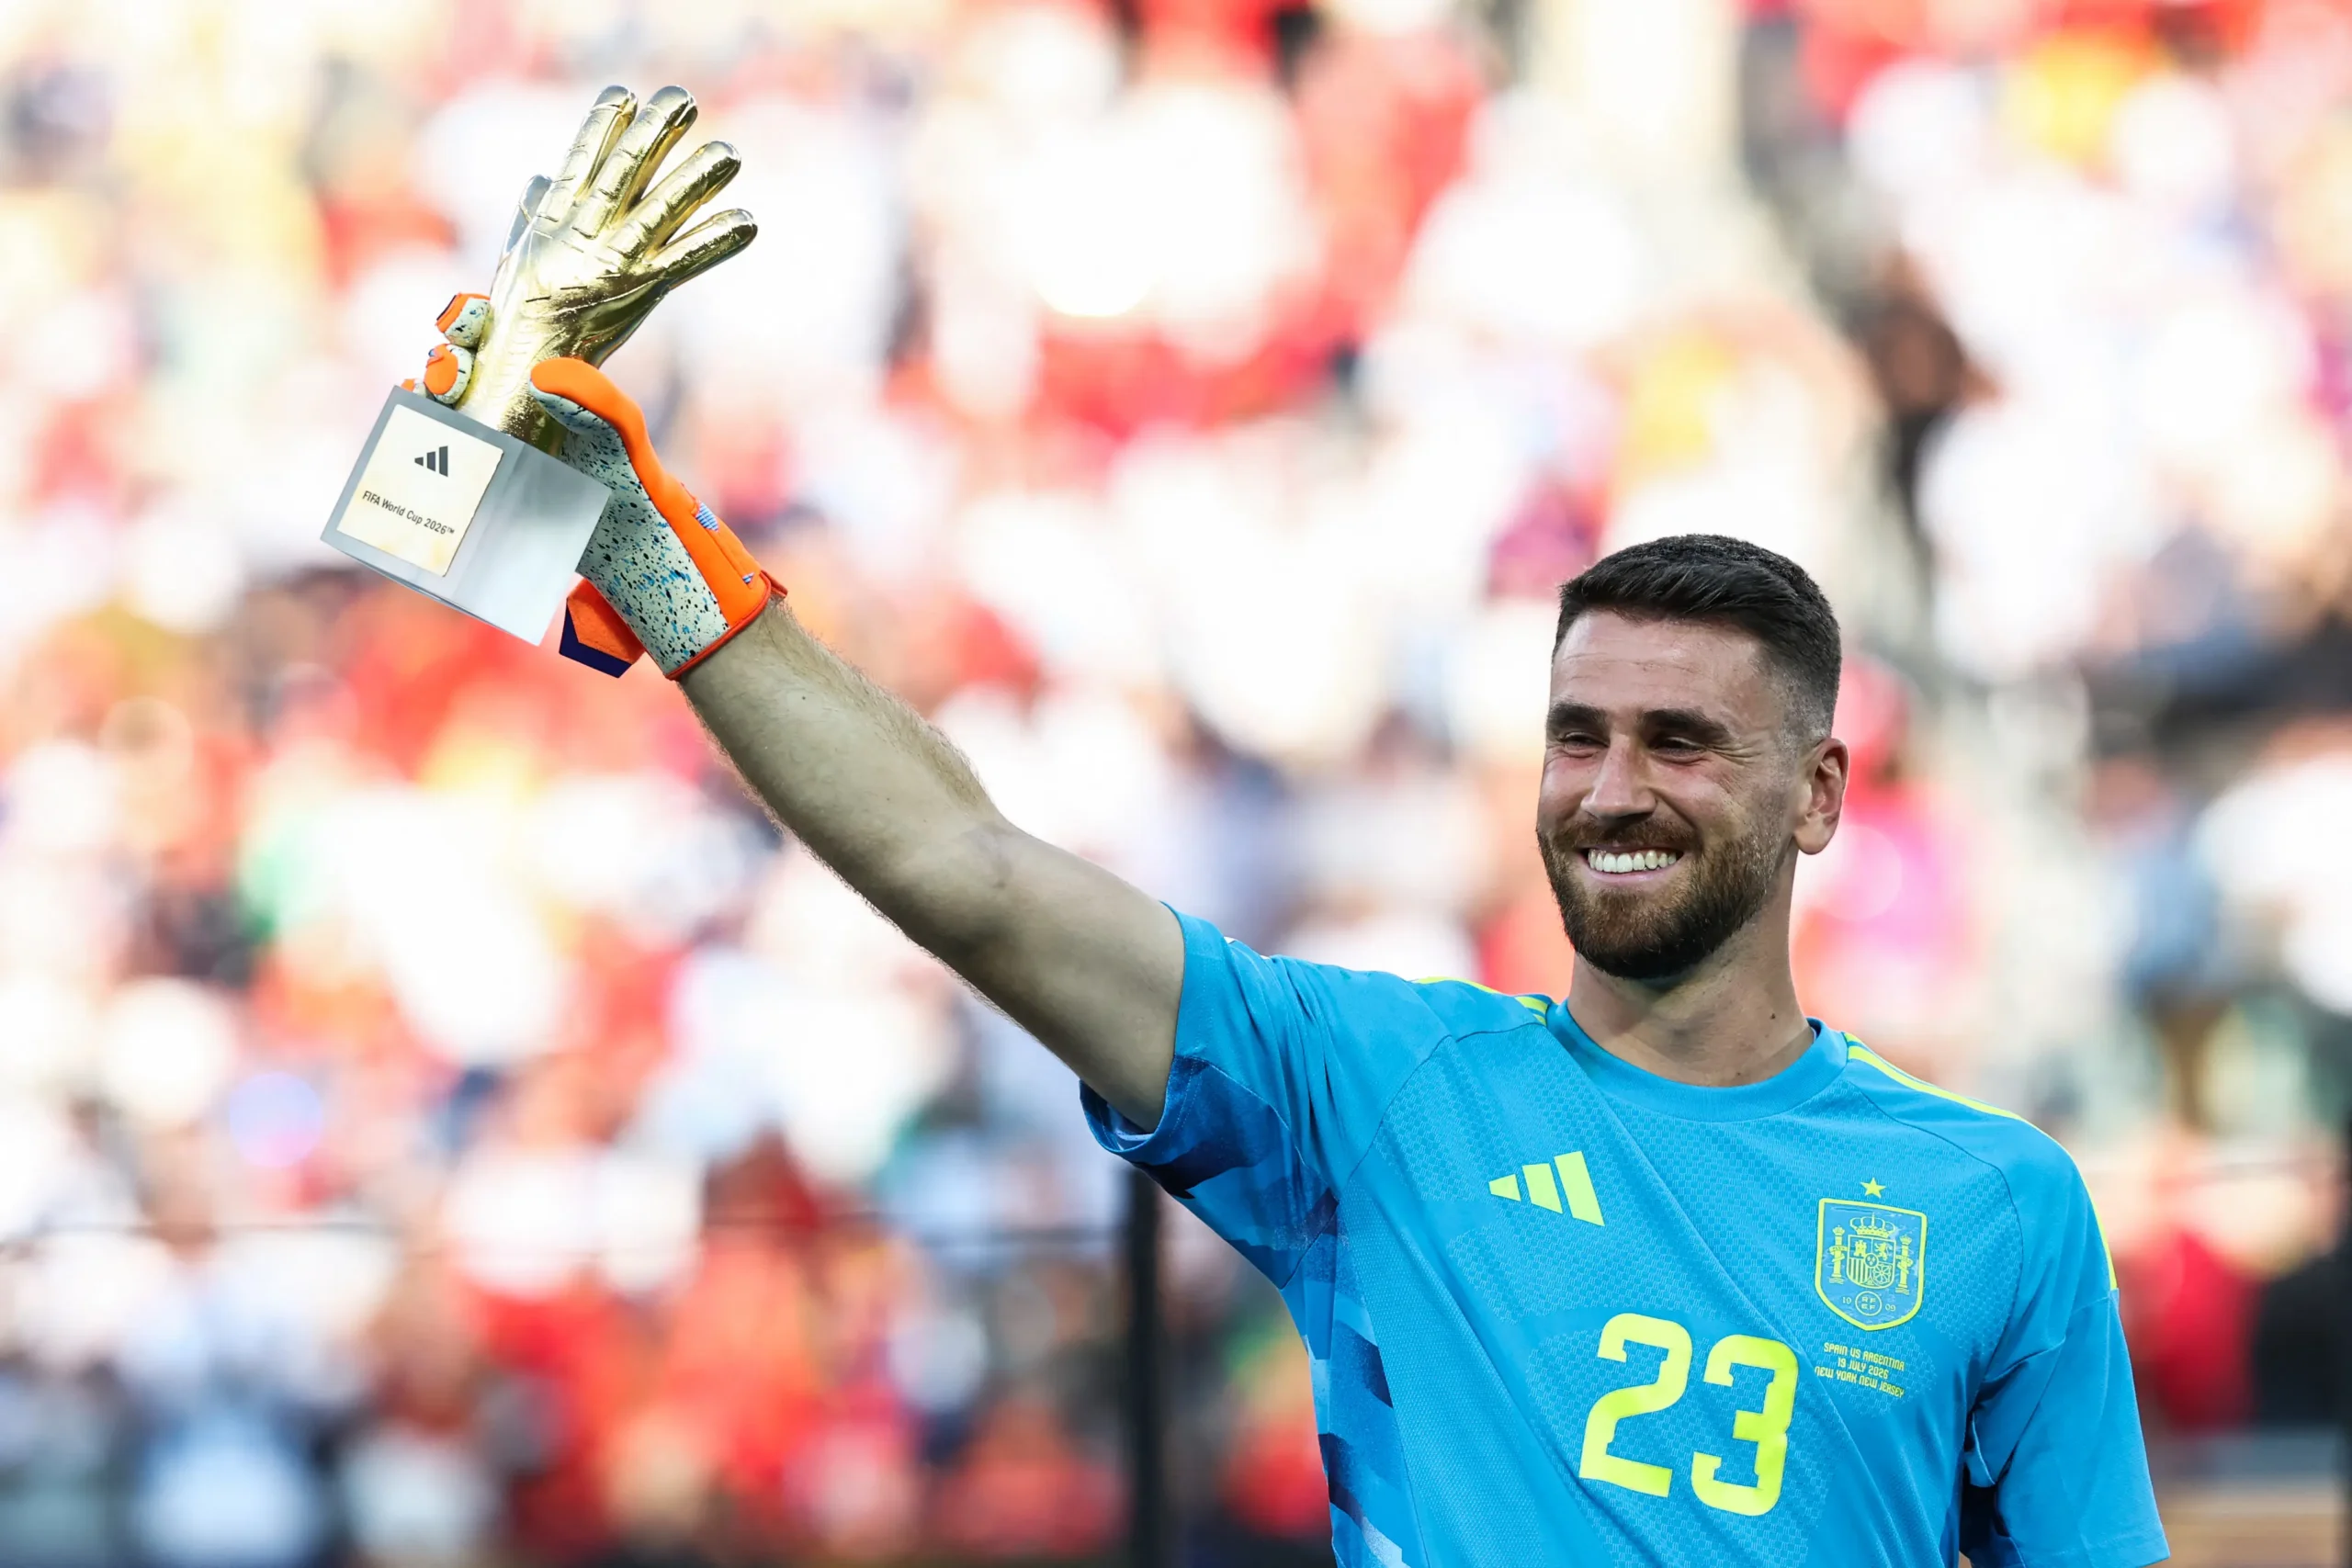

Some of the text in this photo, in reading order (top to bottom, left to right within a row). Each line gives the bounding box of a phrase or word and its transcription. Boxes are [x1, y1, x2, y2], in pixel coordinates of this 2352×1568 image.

[362, 491, 380, 505] FIFA
[381, 498, 406, 516] World
[406, 510, 423, 525] Cup
[1824, 1342, 1849, 1356] SPAIN
[1863, 1350, 1905, 1371] ARGENTINA
[1838, 1357, 1889, 1380] 19 JULY 2026
[1815, 1366, 1905, 1398] NEW YORK NEW JERSEY
[1578, 1313, 1799, 1517] 23
